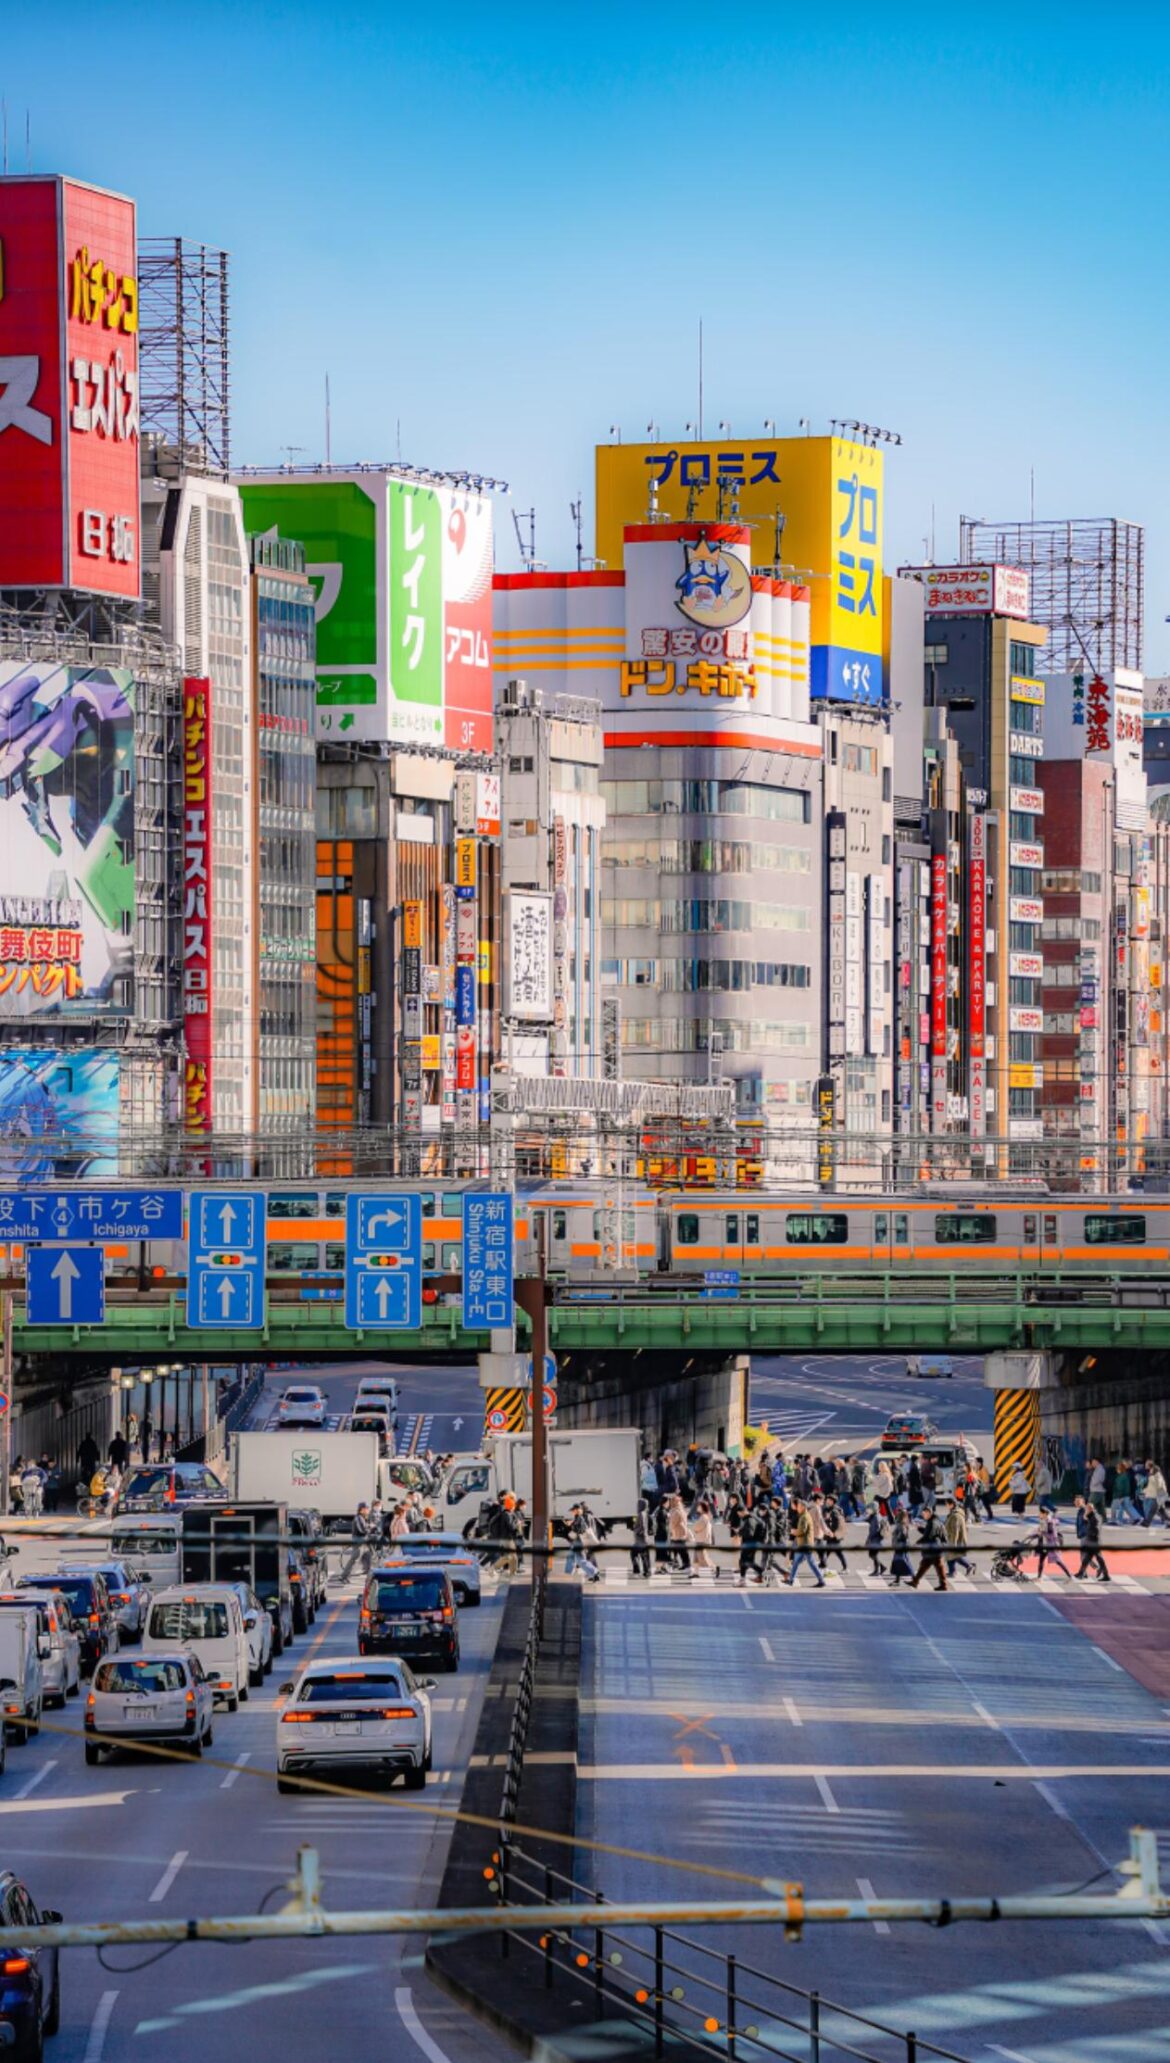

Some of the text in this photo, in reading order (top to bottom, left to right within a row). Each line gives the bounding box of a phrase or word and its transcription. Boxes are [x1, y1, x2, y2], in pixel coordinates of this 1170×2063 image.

[72, 245, 138, 333] パチンコ
[71, 347, 139, 442] エスパス
[645, 450, 782, 486] プロミス
[82, 508, 136, 563] 日拓
[402, 495, 427, 670] レイク
[936, 570, 980, 585] カラオケ
[446, 625, 490, 669] アコム
[851, 660, 872, 692] すぐ
[461, 721, 476, 745] 3F
[1086, 673, 1112, 750] 東海苑
[1009, 733, 1045, 756] DARTS
[973, 816, 982, 846] 300
[973, 861, 982, 938] KARAOKE
[0, 929, 83, 961] 舞伎町
[973, 960, 982, 1014] PARTY
[57, 1211, 68, 1223] 4
[93, 1223, 150, 1238] Ichigaya
[467, 1203, 484, 1265] Shinjuku
[484, 1200, 508, 1321] 新宿駅東口
